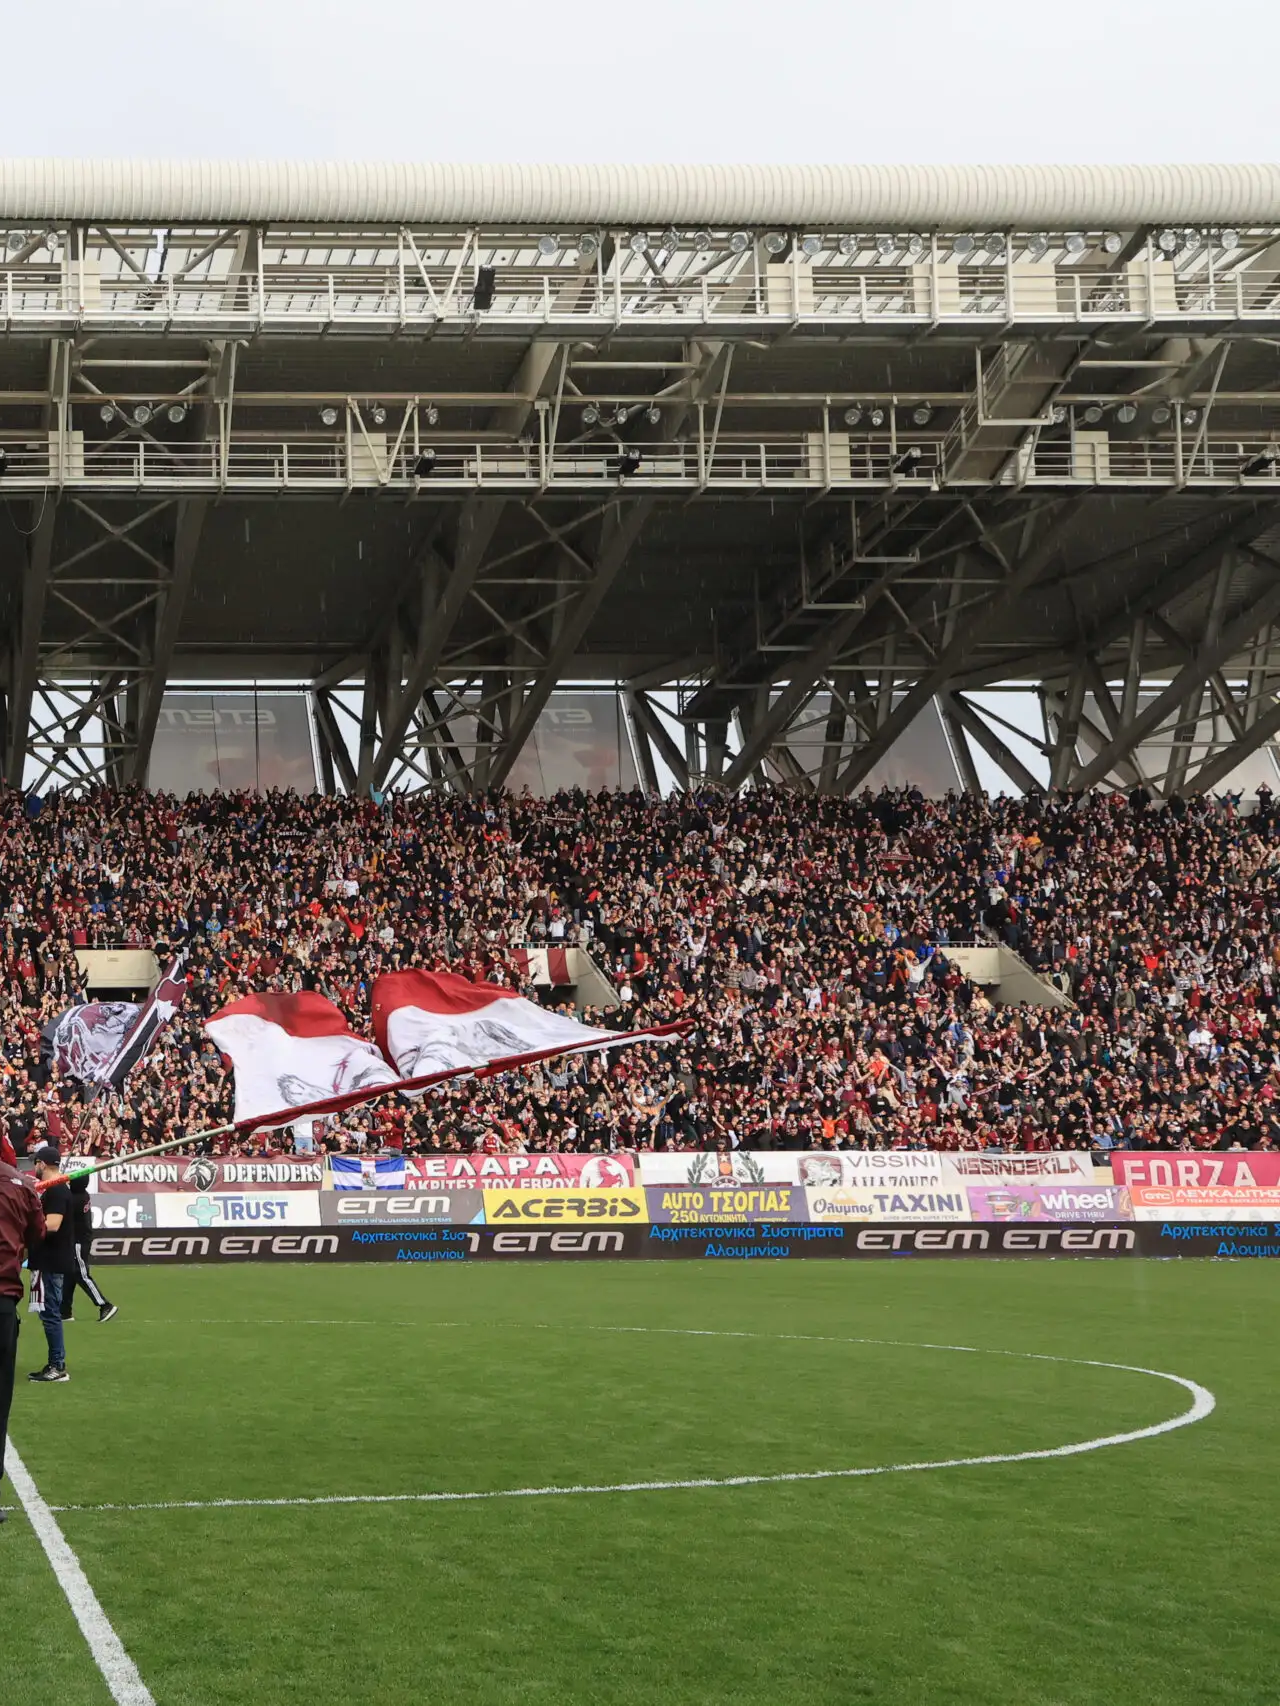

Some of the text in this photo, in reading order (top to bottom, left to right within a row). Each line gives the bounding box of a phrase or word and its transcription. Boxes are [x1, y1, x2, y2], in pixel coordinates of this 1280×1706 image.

[846, 1155, 935, 1168] VISSINI
[100, 1162, 322, 1183] CRIMSON DEFENDERS
[1123, 1159, 1257, 1187] FORZA
[337, 1196, 450, 1214] ETEM
[662, 1190, 791, 1212] AUTO ΤΣΟΓΙΑΣ
[873, 1194, 963, 1212] TAXINI
[1040, 1188, 1114, 1209] wheel
[670, 1210, 698, 1223] 250
[352, 1230, 437, 1243] Αρχιτεκτονικά
[649, 1223, 844, 1241] Αρχιτεκτονικά Συστήματα
[856, 1229, 990, 1250] ETEM
[1002, 1229, 1135, 1249] ETEM
[1161, 1222, 1268, 1240] Αρχιτεκτονικά
[90, 1236, 209, 1256] ETEM
[220, 1235, 339, 1254] ETEM
[493, 1231, 624, 1252] ETEM
[396, 1247, 465, 1261] Αλουμινίου
[705, 1242, 789, 1260] Αλουμινίου
